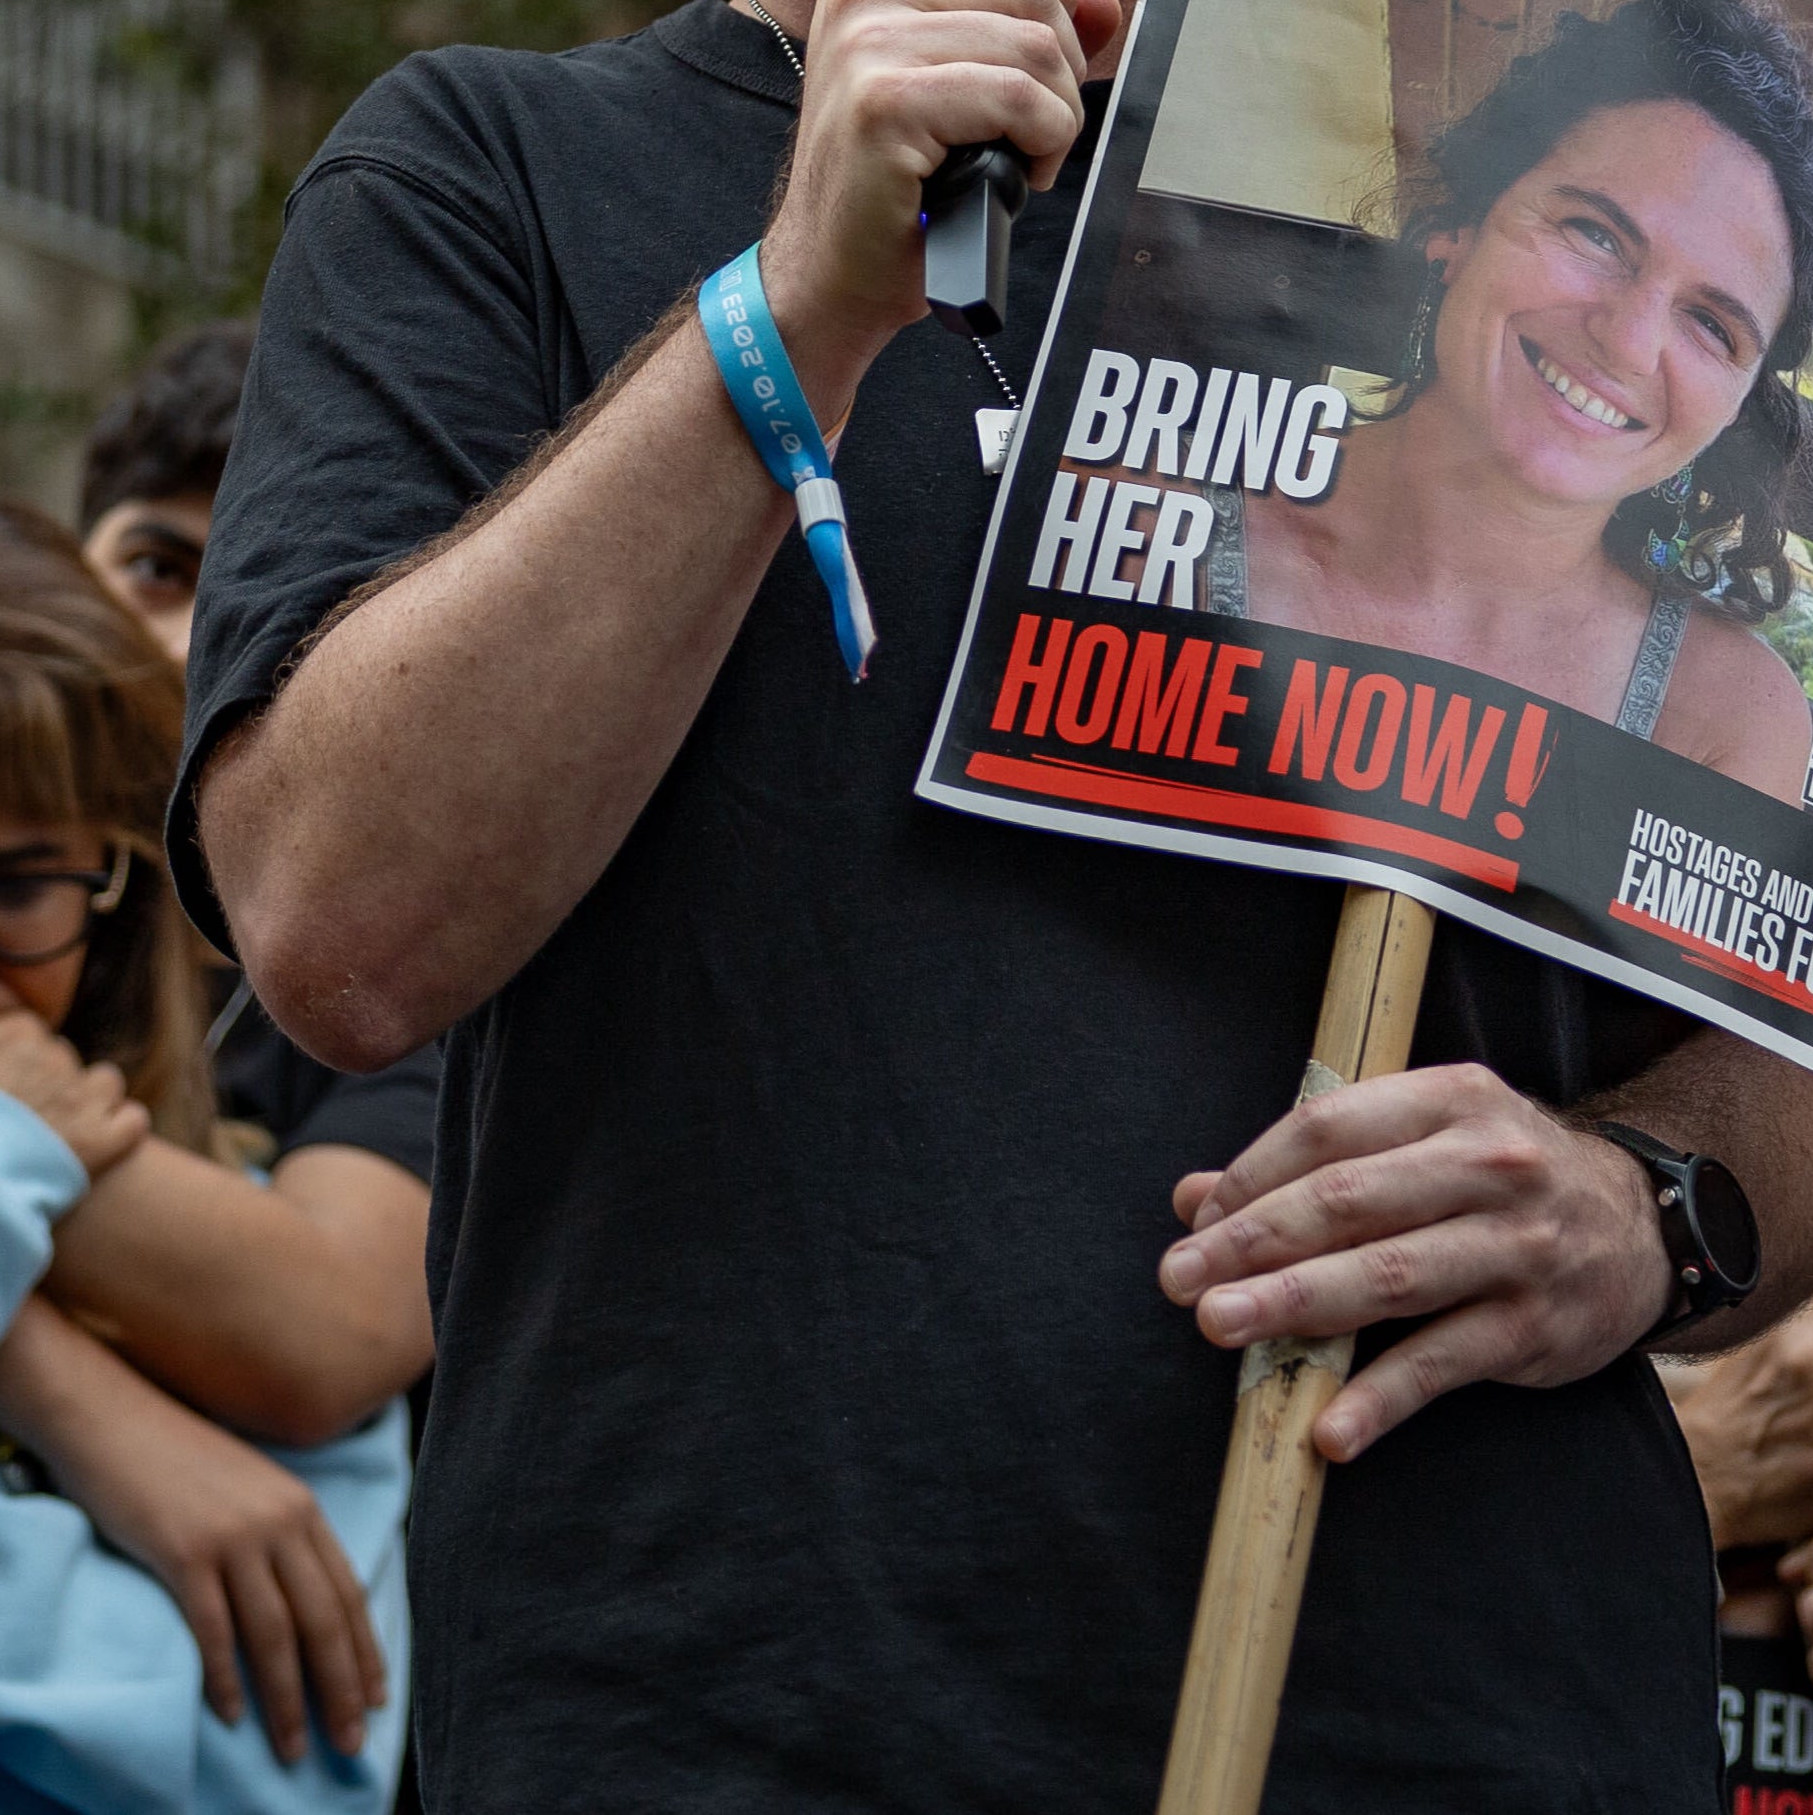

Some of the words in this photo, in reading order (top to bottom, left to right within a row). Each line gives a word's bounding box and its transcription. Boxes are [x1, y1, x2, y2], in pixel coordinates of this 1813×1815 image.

[1062, 348, 1347, 499] BRING
[1028, 471, 1214, 610] HER
[990, 613, 1264, 767] HOME
[1267, 658, 1556, 841] NOW!
[1617, 848, 1785, 972] FAMILIES
[1630, 808, 1762, 899] HOSTAGES
